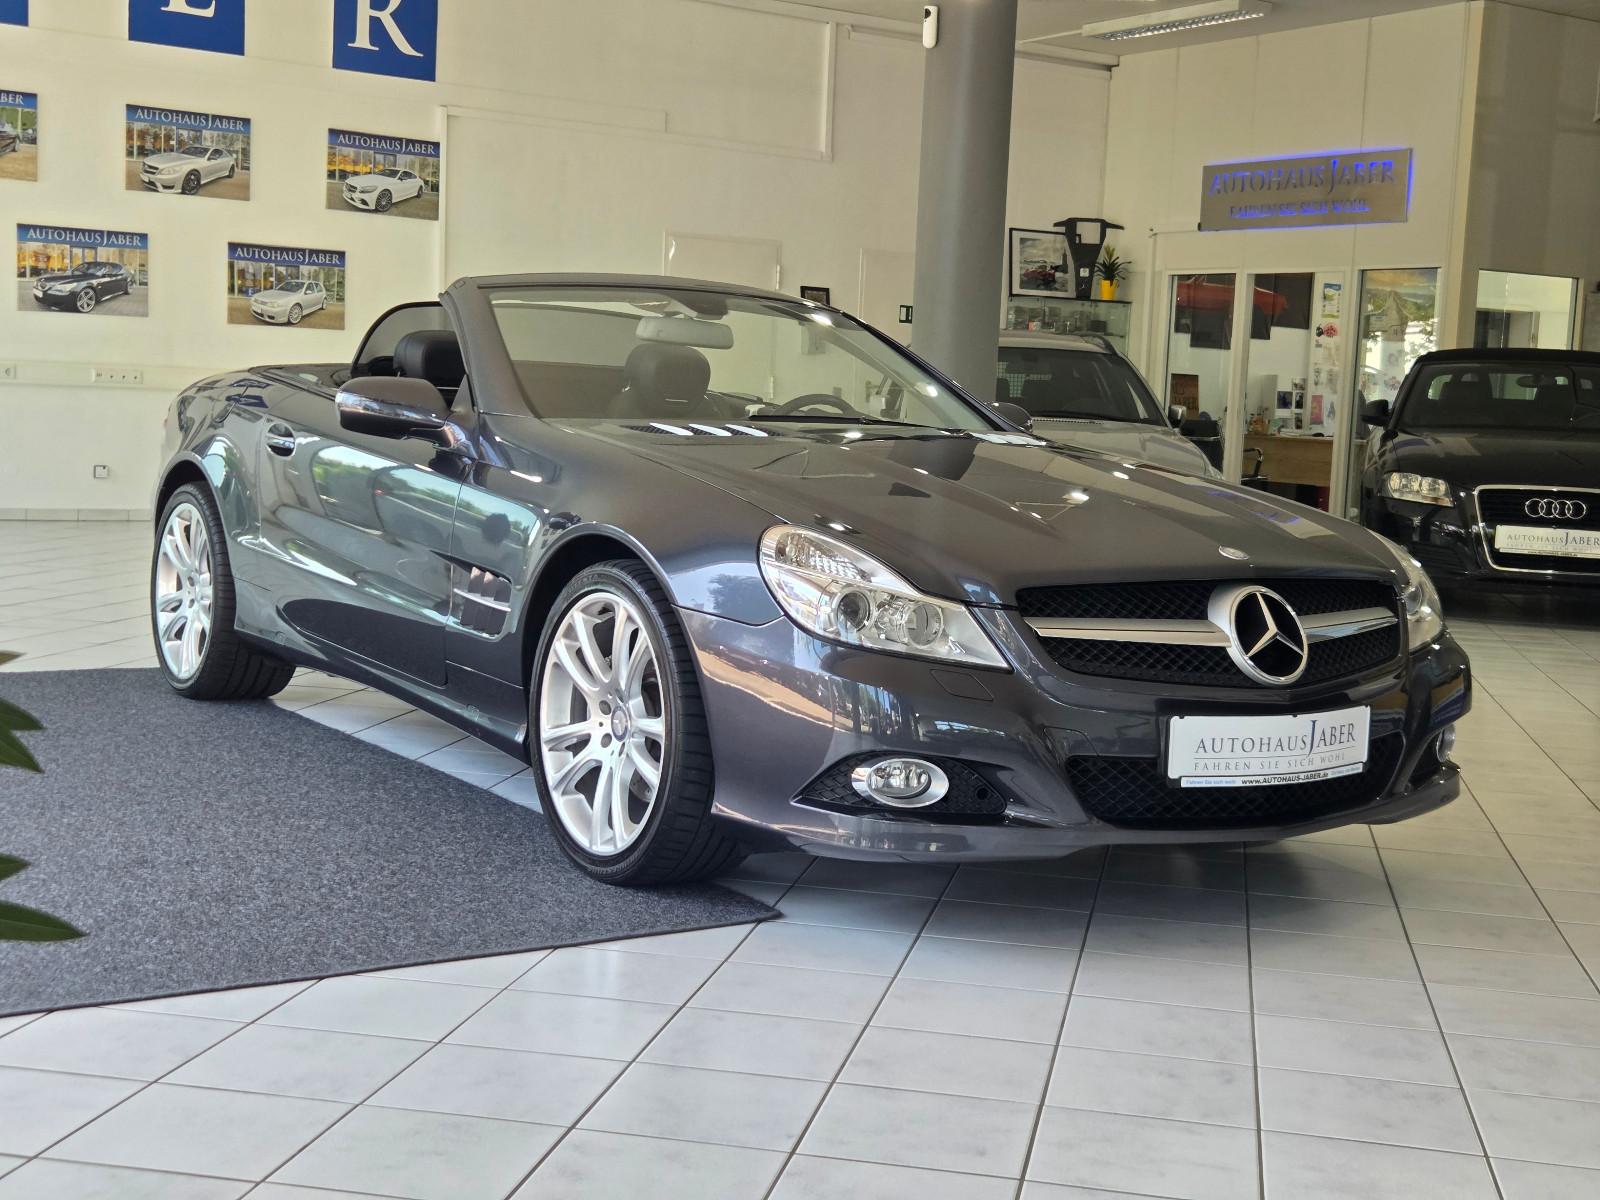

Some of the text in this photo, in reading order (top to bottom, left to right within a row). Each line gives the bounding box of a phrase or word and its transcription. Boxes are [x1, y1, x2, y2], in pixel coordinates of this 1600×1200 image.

[1194, 760, 1251, 771] FAHREN
[1260, 760, 1280, 769] SIE
[1287, 756, 1314, 768] SICH
